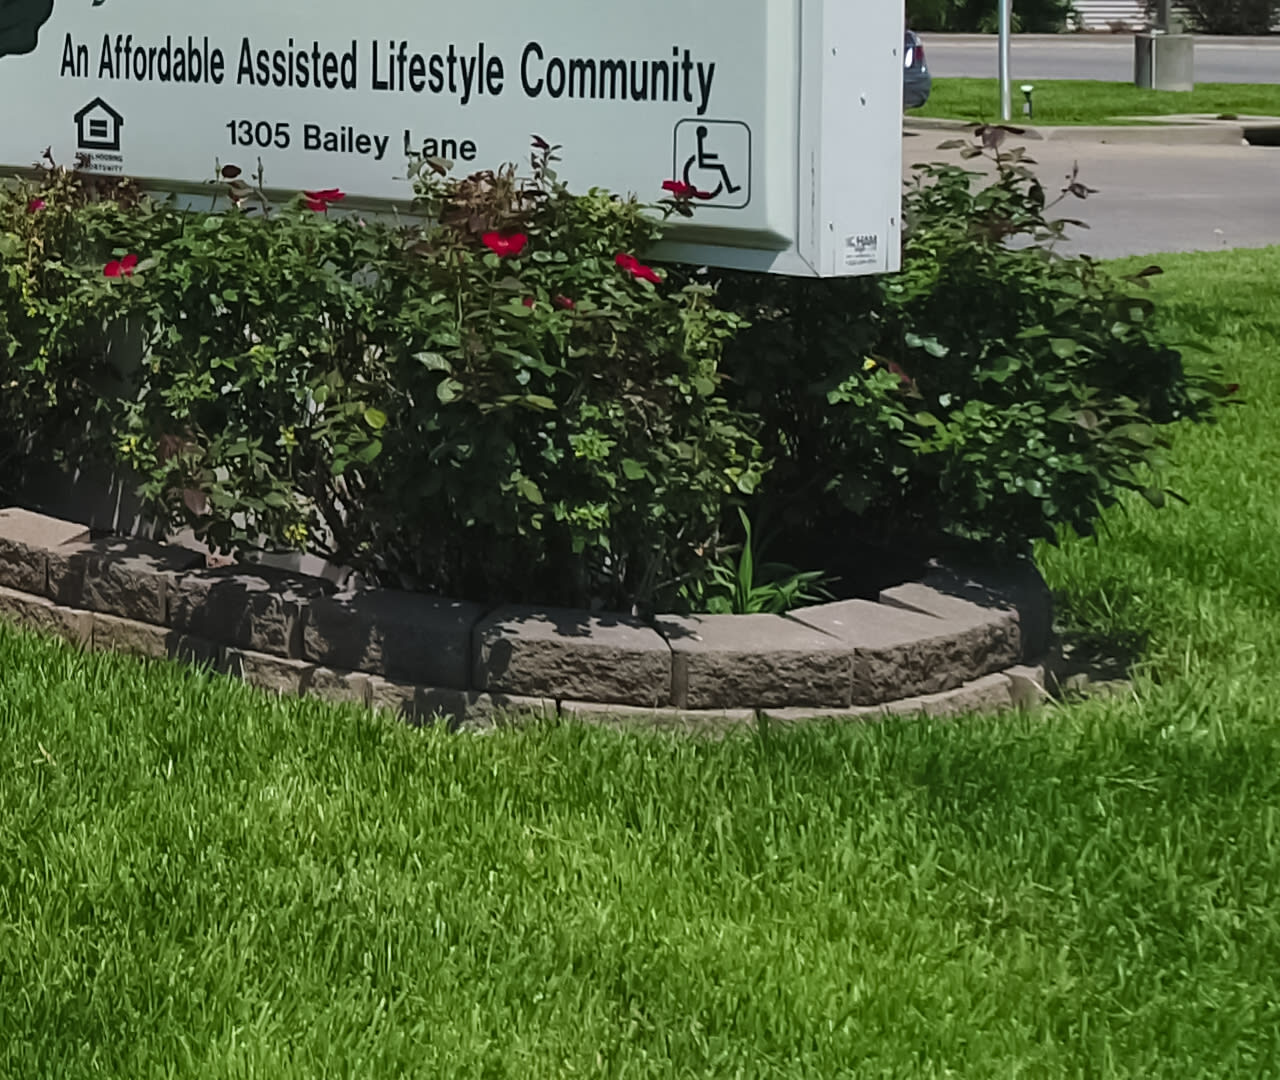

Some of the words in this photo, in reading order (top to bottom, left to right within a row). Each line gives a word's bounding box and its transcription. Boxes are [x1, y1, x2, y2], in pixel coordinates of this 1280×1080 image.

[60, 33, 89, 78] An
[98, 34, 224, 85] Affordable
[237, 37, 357, 91] Assisted
[371, 39, 504, 105] Lifestyle
[520, 41, 715, 115] Community
[226, 120, 290, 149] 1305
[303, 124, 389, 160] Bailey
[404, 129, 477, 161] Lane
